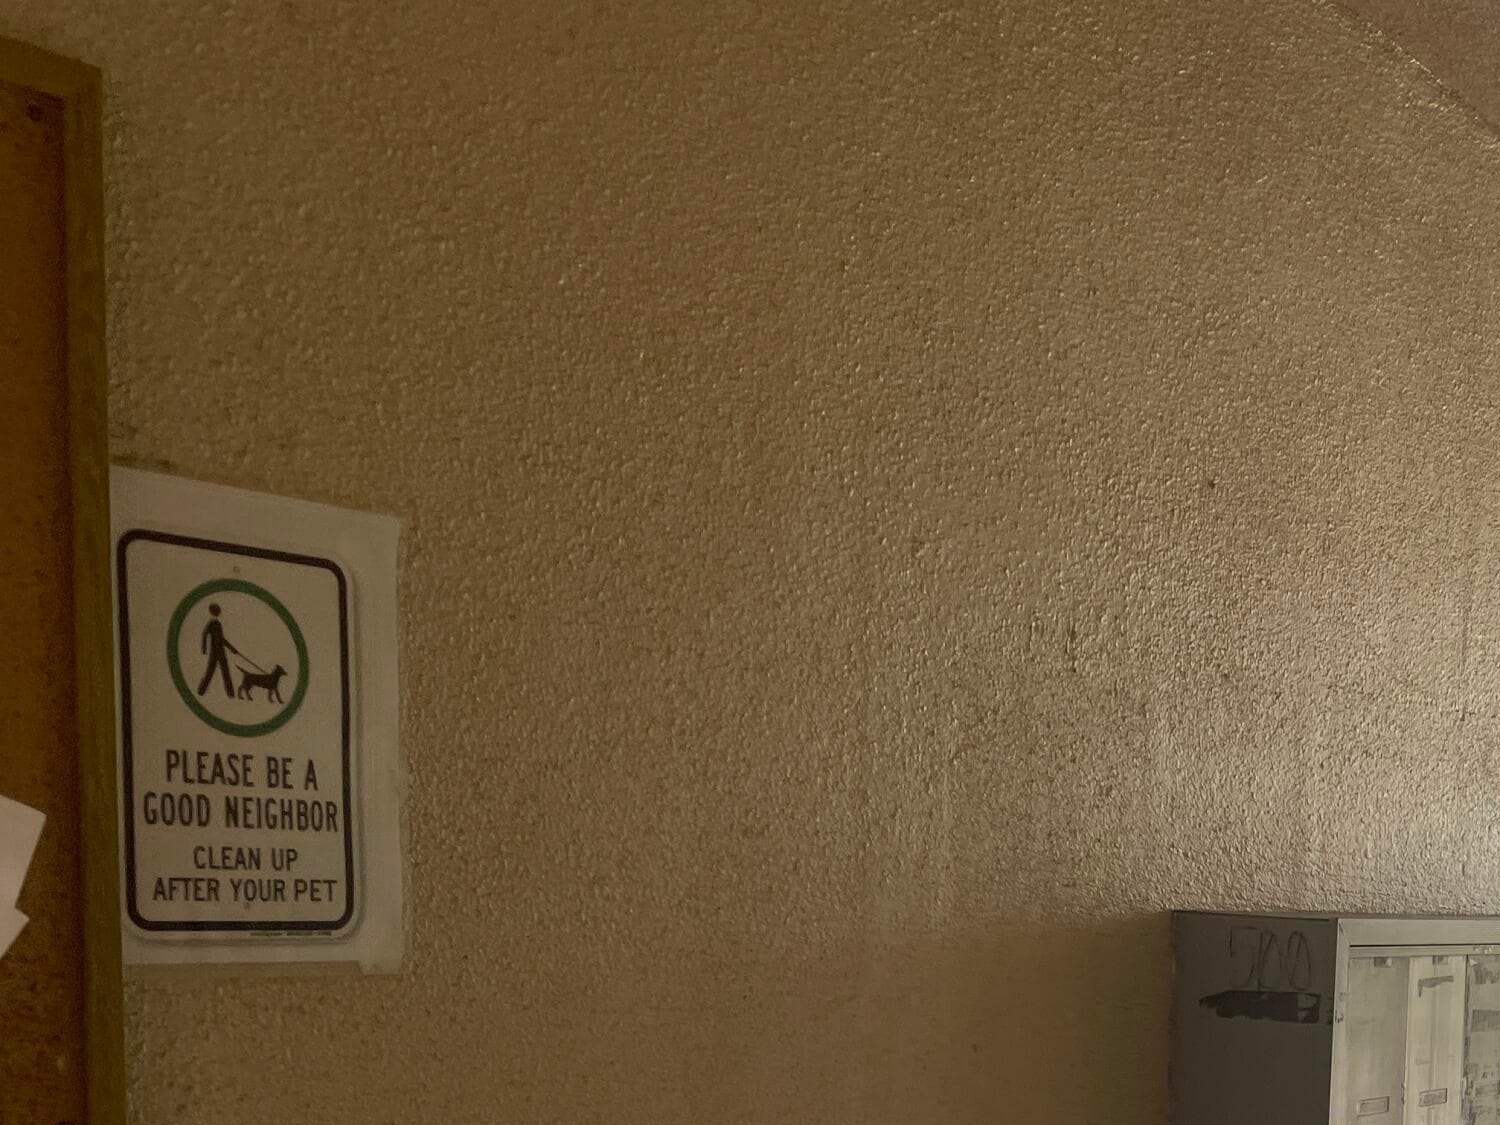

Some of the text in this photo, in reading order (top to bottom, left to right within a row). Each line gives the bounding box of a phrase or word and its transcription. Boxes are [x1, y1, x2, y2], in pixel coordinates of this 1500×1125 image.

[165, 749, 319, 791] PLEASE BE A
[143, 791, 338, 832] GOOD NEIGHBOR
[193, 846, 298, 871] CLEAN UP
[152, 877, 338, 902] AFTER YOUR PET
